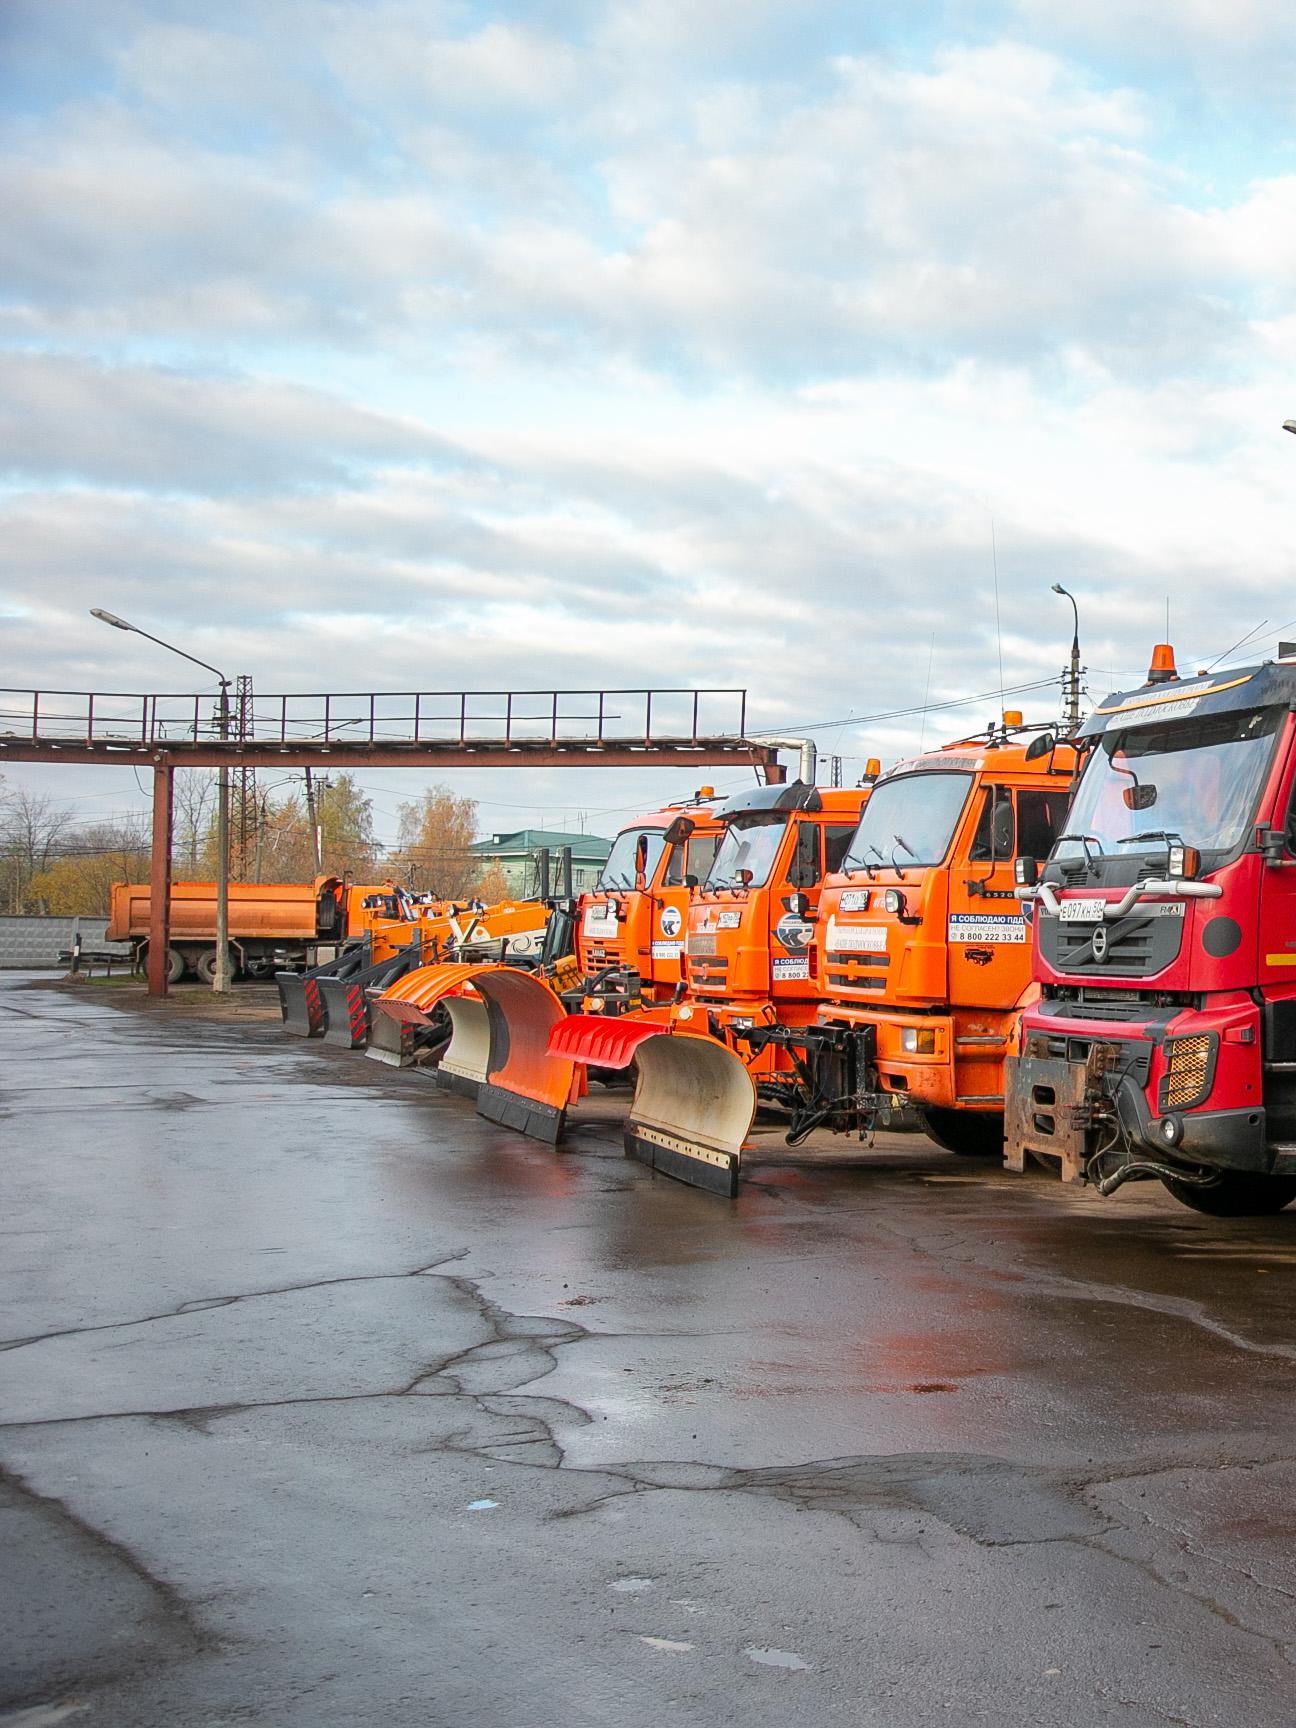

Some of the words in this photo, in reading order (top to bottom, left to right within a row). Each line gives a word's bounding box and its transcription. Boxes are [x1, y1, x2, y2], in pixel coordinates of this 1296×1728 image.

[958, 915, 1006, 924] СОБЛЮДАЮ
[1007, 916, 1024, 925] ПДД
[967, 933, 983, 941] 800
[1014, 934, 1024, 942] 44
